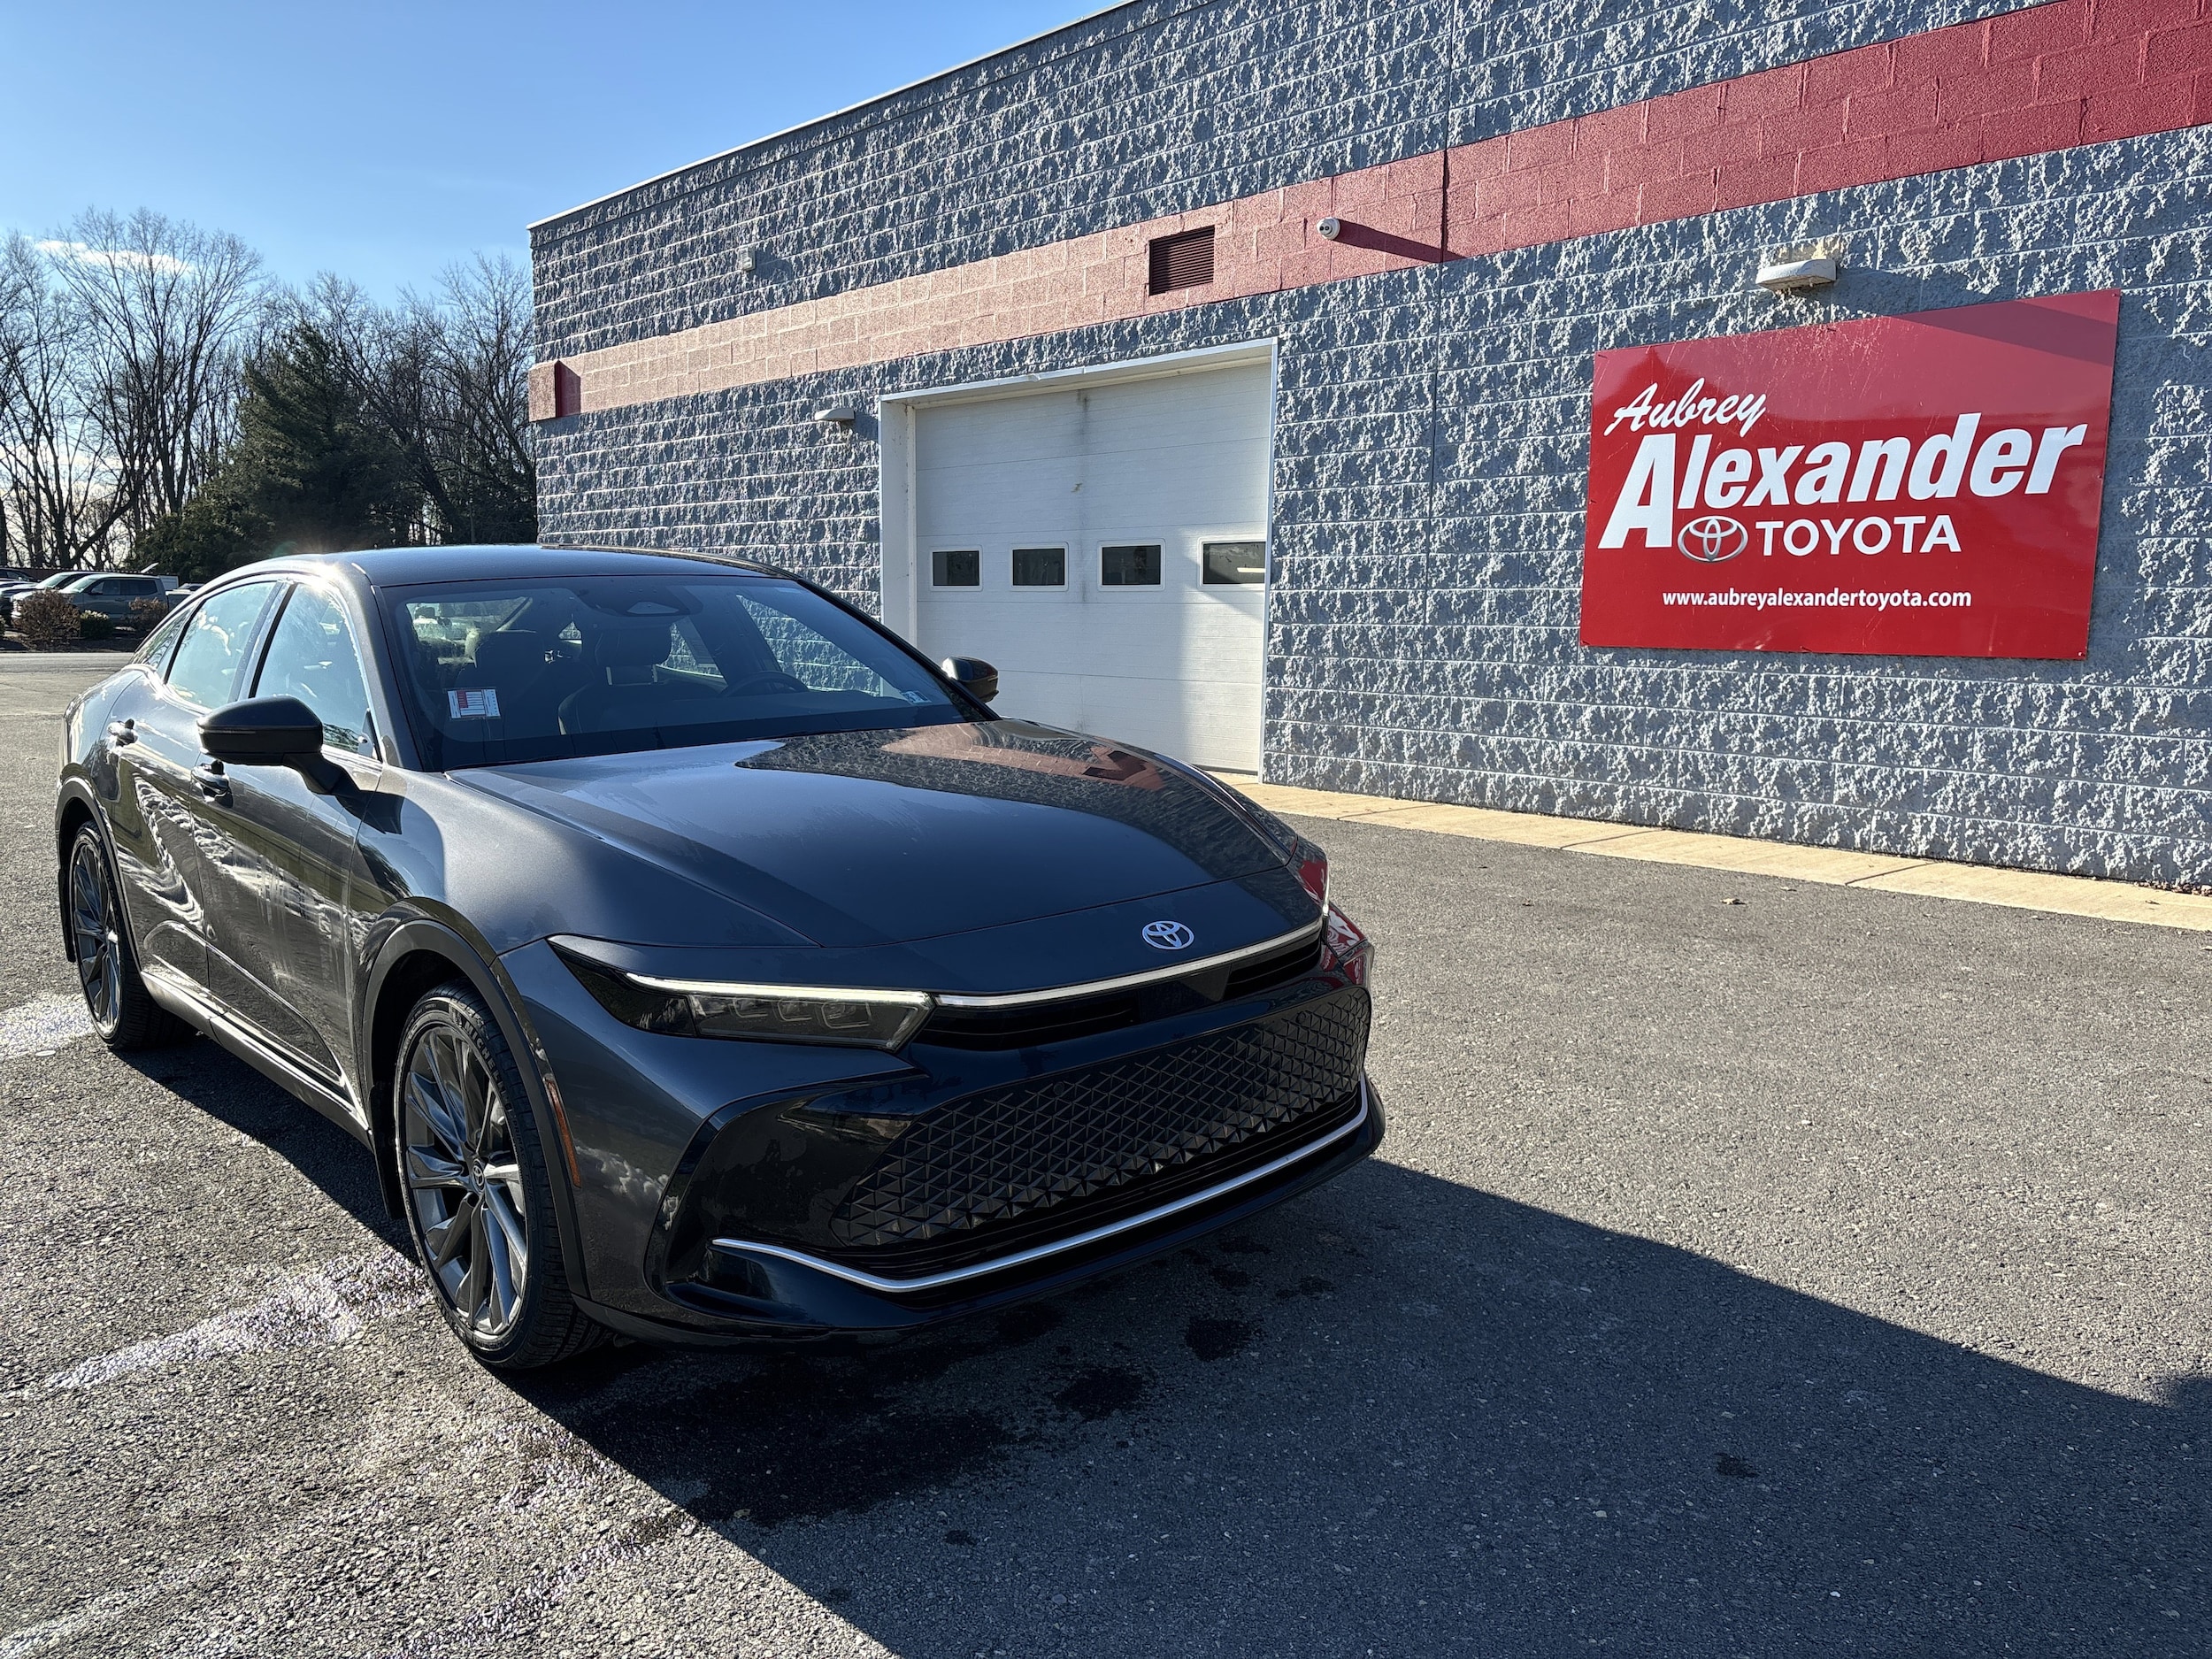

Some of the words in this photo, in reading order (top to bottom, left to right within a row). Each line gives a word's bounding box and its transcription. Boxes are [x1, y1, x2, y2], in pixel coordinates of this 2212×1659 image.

[1603, 377, 1767, 438] Aubrey
[1597, 412, 2089, 549] Alexander
[1755, 514, 1962, 557] TOYOTA
[1662, 587, 1972, 612] www.aubreyalexandertoyota.com
